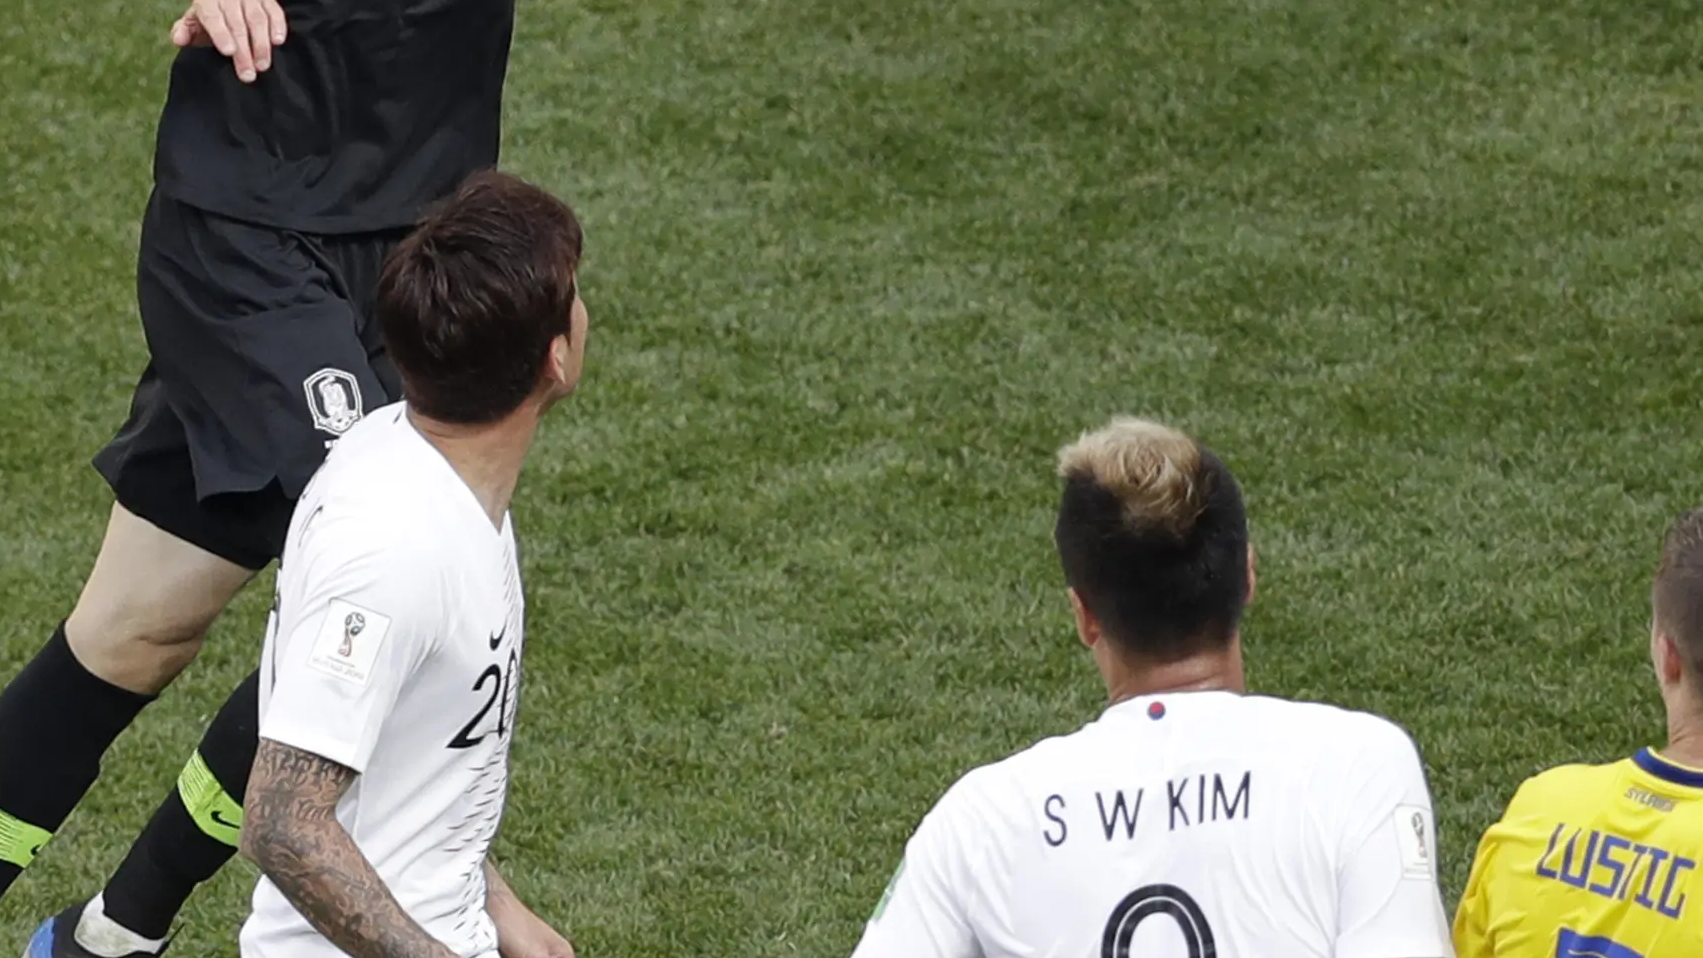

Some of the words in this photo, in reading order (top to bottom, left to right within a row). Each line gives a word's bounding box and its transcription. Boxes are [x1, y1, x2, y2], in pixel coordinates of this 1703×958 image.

[444, 648, 520, 751] 20
[1042, 793, 1069, 848] S
[1095, 787, 1145, 843] W
[1167, 770, 1254, 833] KIM
[1535, 822, 1697, 920] LUSTIG
